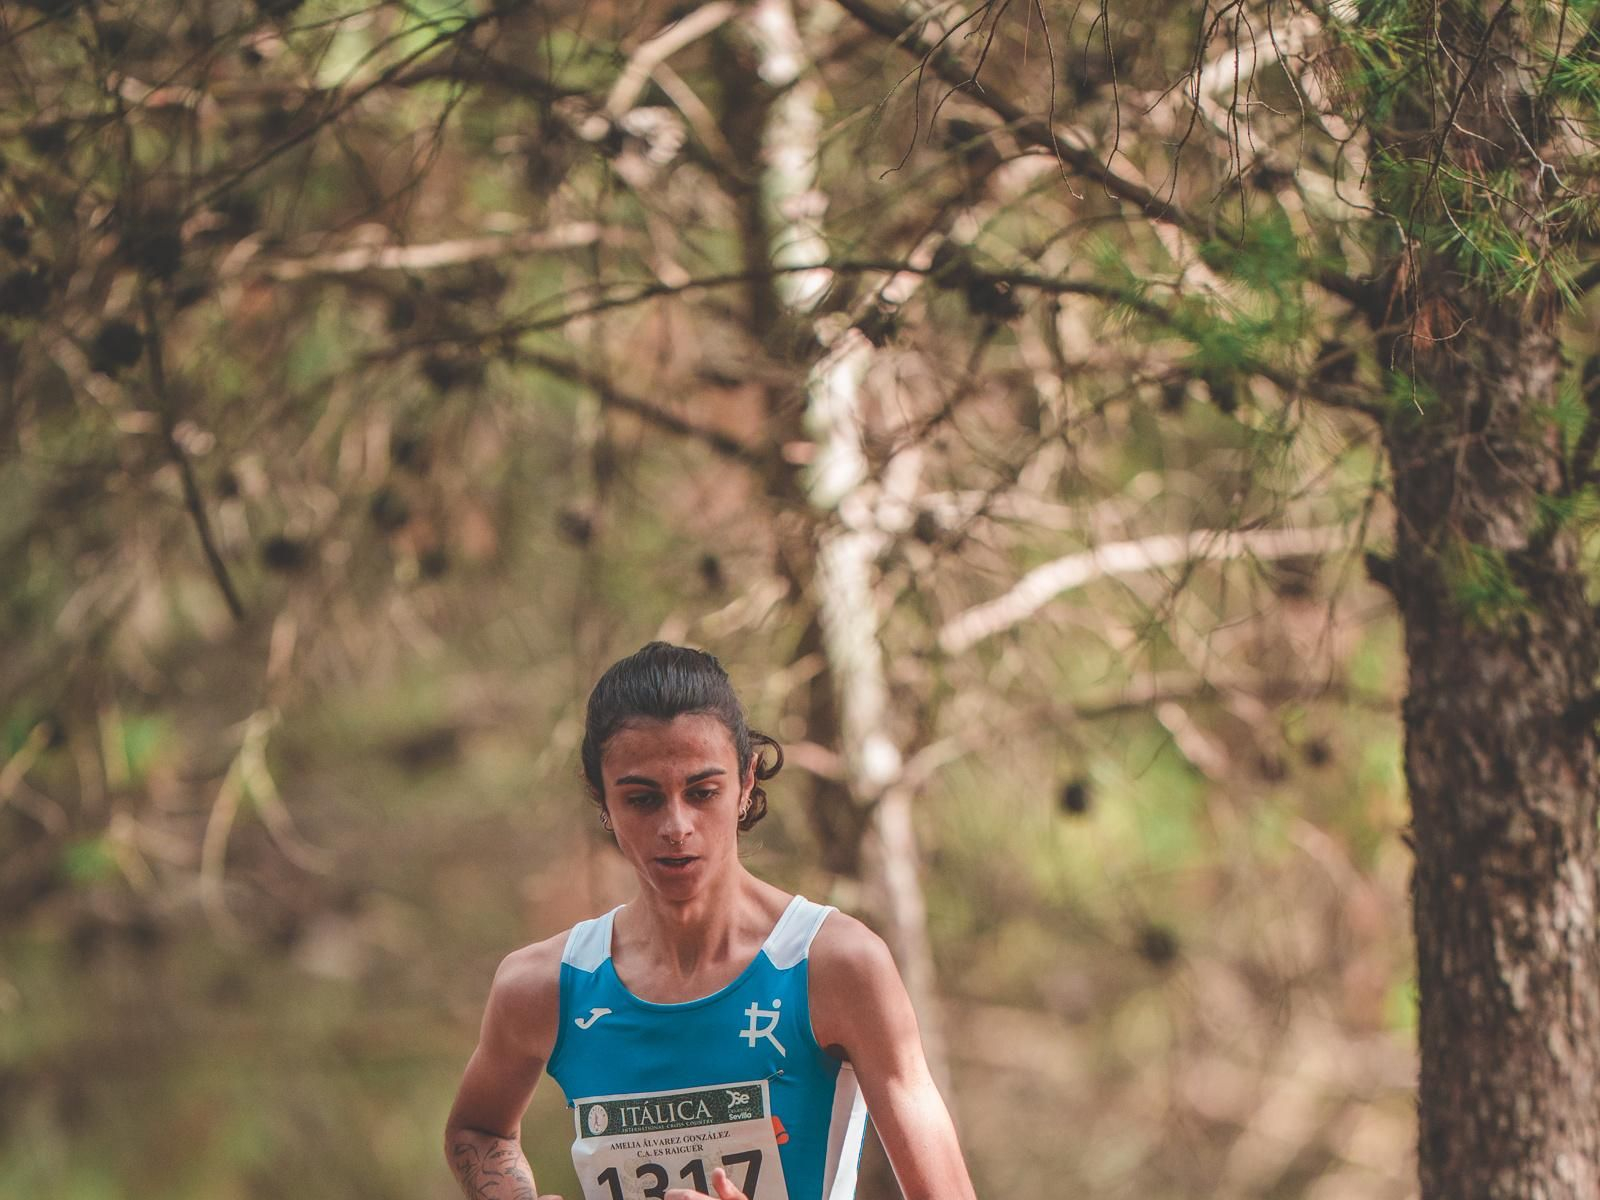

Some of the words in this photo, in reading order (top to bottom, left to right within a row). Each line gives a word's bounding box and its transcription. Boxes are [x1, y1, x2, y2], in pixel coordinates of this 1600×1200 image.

[620, 1099, 713, 1127] ITÁLICA
[728, 1112, 752, 1121] Sevilla
[610, 1140, 641, 1151] AMELIA
[643, 1136, 681, 1147] ÁLVAREZ
[683, 1130, 731, 1143] GONZÁLEZ
[637, 1150, 652, 1158] C.A.
[653, 1148, 664, 1157] ES
